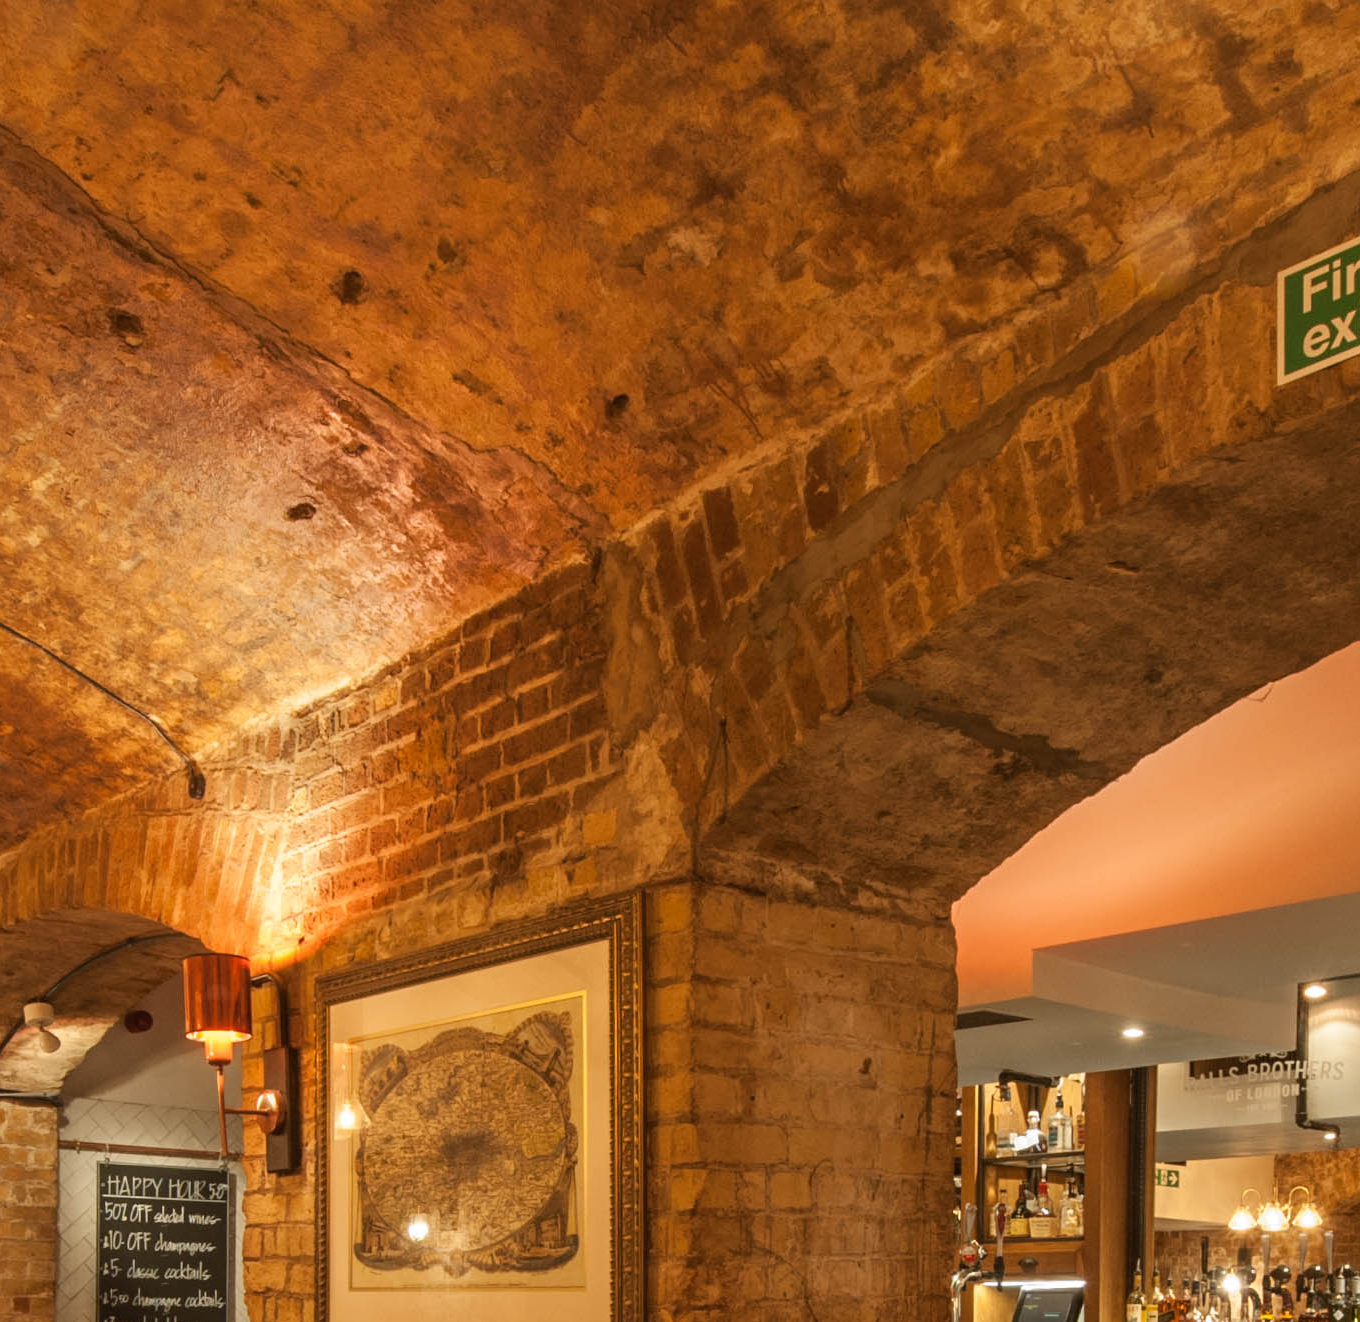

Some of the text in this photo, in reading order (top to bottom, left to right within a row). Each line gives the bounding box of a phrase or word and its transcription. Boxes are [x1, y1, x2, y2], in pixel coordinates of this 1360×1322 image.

[1247, 1060, 1345, 1083] BROTHERS
[1226, 1083, 1300, 1102] OF LONDON
[107, 1175, 163, 1198] HAPPY
[168, 1178, 206, 1200] HOUR
[104, 1201, 222, 1225] 50% OFF selected wines
[127, 1231, 152, 1251] OFF
[127, 1259, 160, 1279] classic
[163, 1260, 212, 1280] cocktails
[184, 1288, 226, 1308] cocktails
